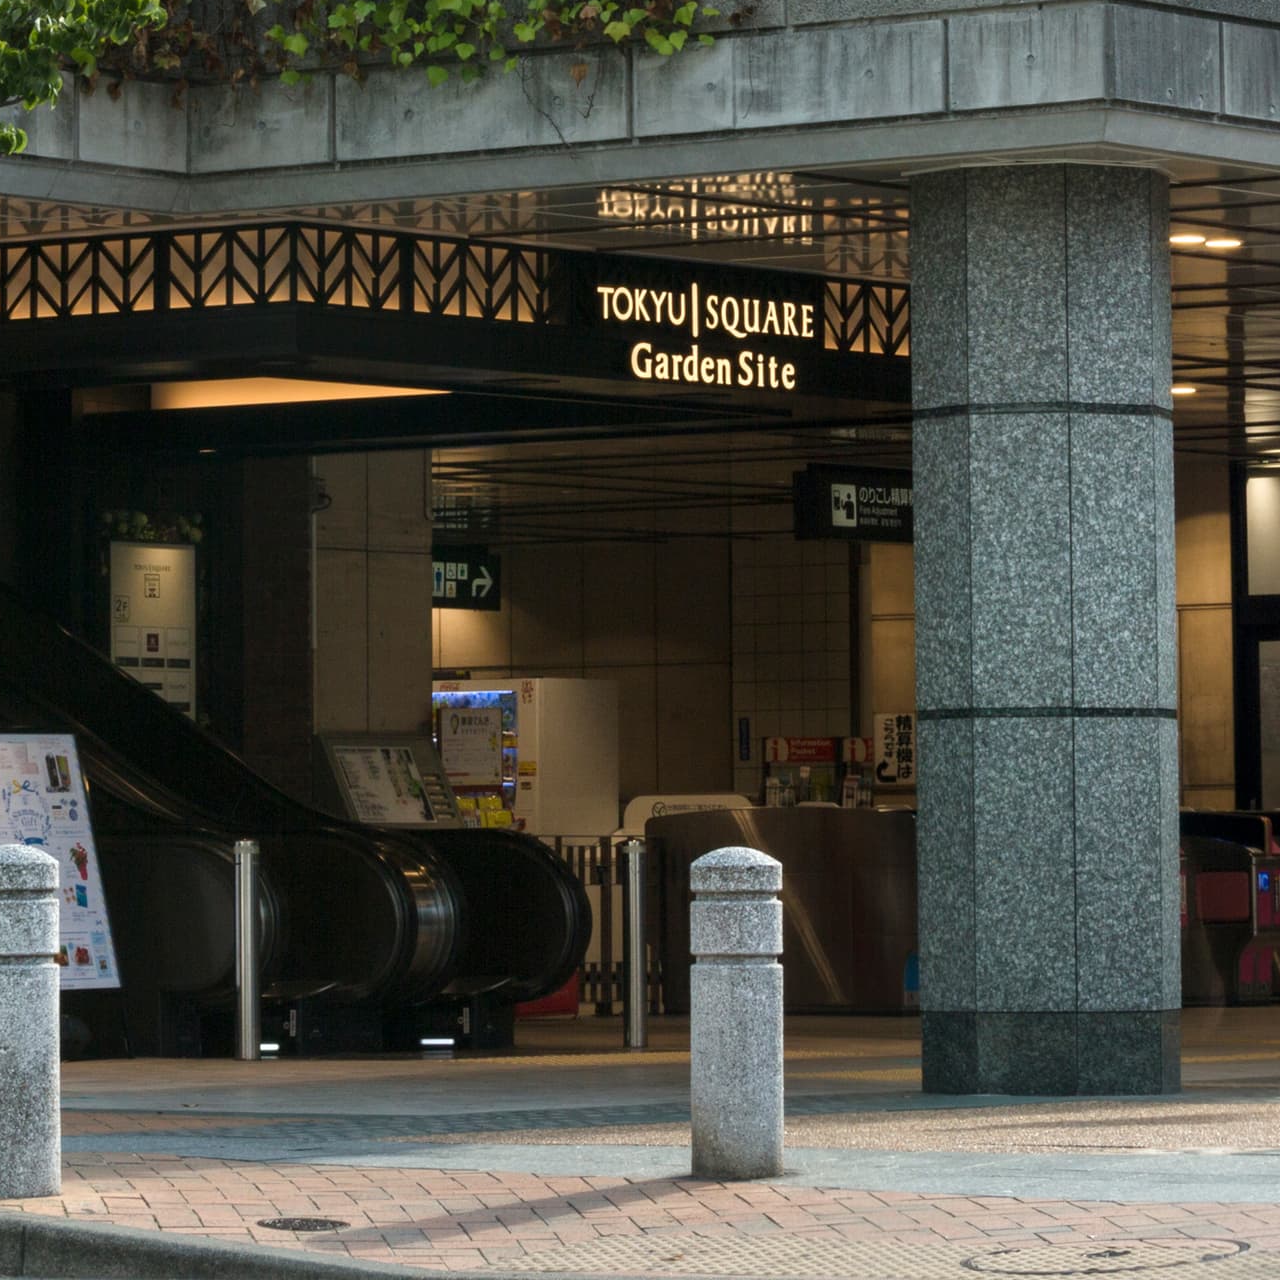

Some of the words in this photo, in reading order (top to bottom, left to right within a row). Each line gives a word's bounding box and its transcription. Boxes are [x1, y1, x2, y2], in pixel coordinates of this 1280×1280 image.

[597, 286, 686, 326] TOKYU
[705, 295, 815, 339] SQUARE
[631, 342, 732, 385] Garden
[738, 351, 796, 390] Site
[894, 715, 913, 779] 精算機は
